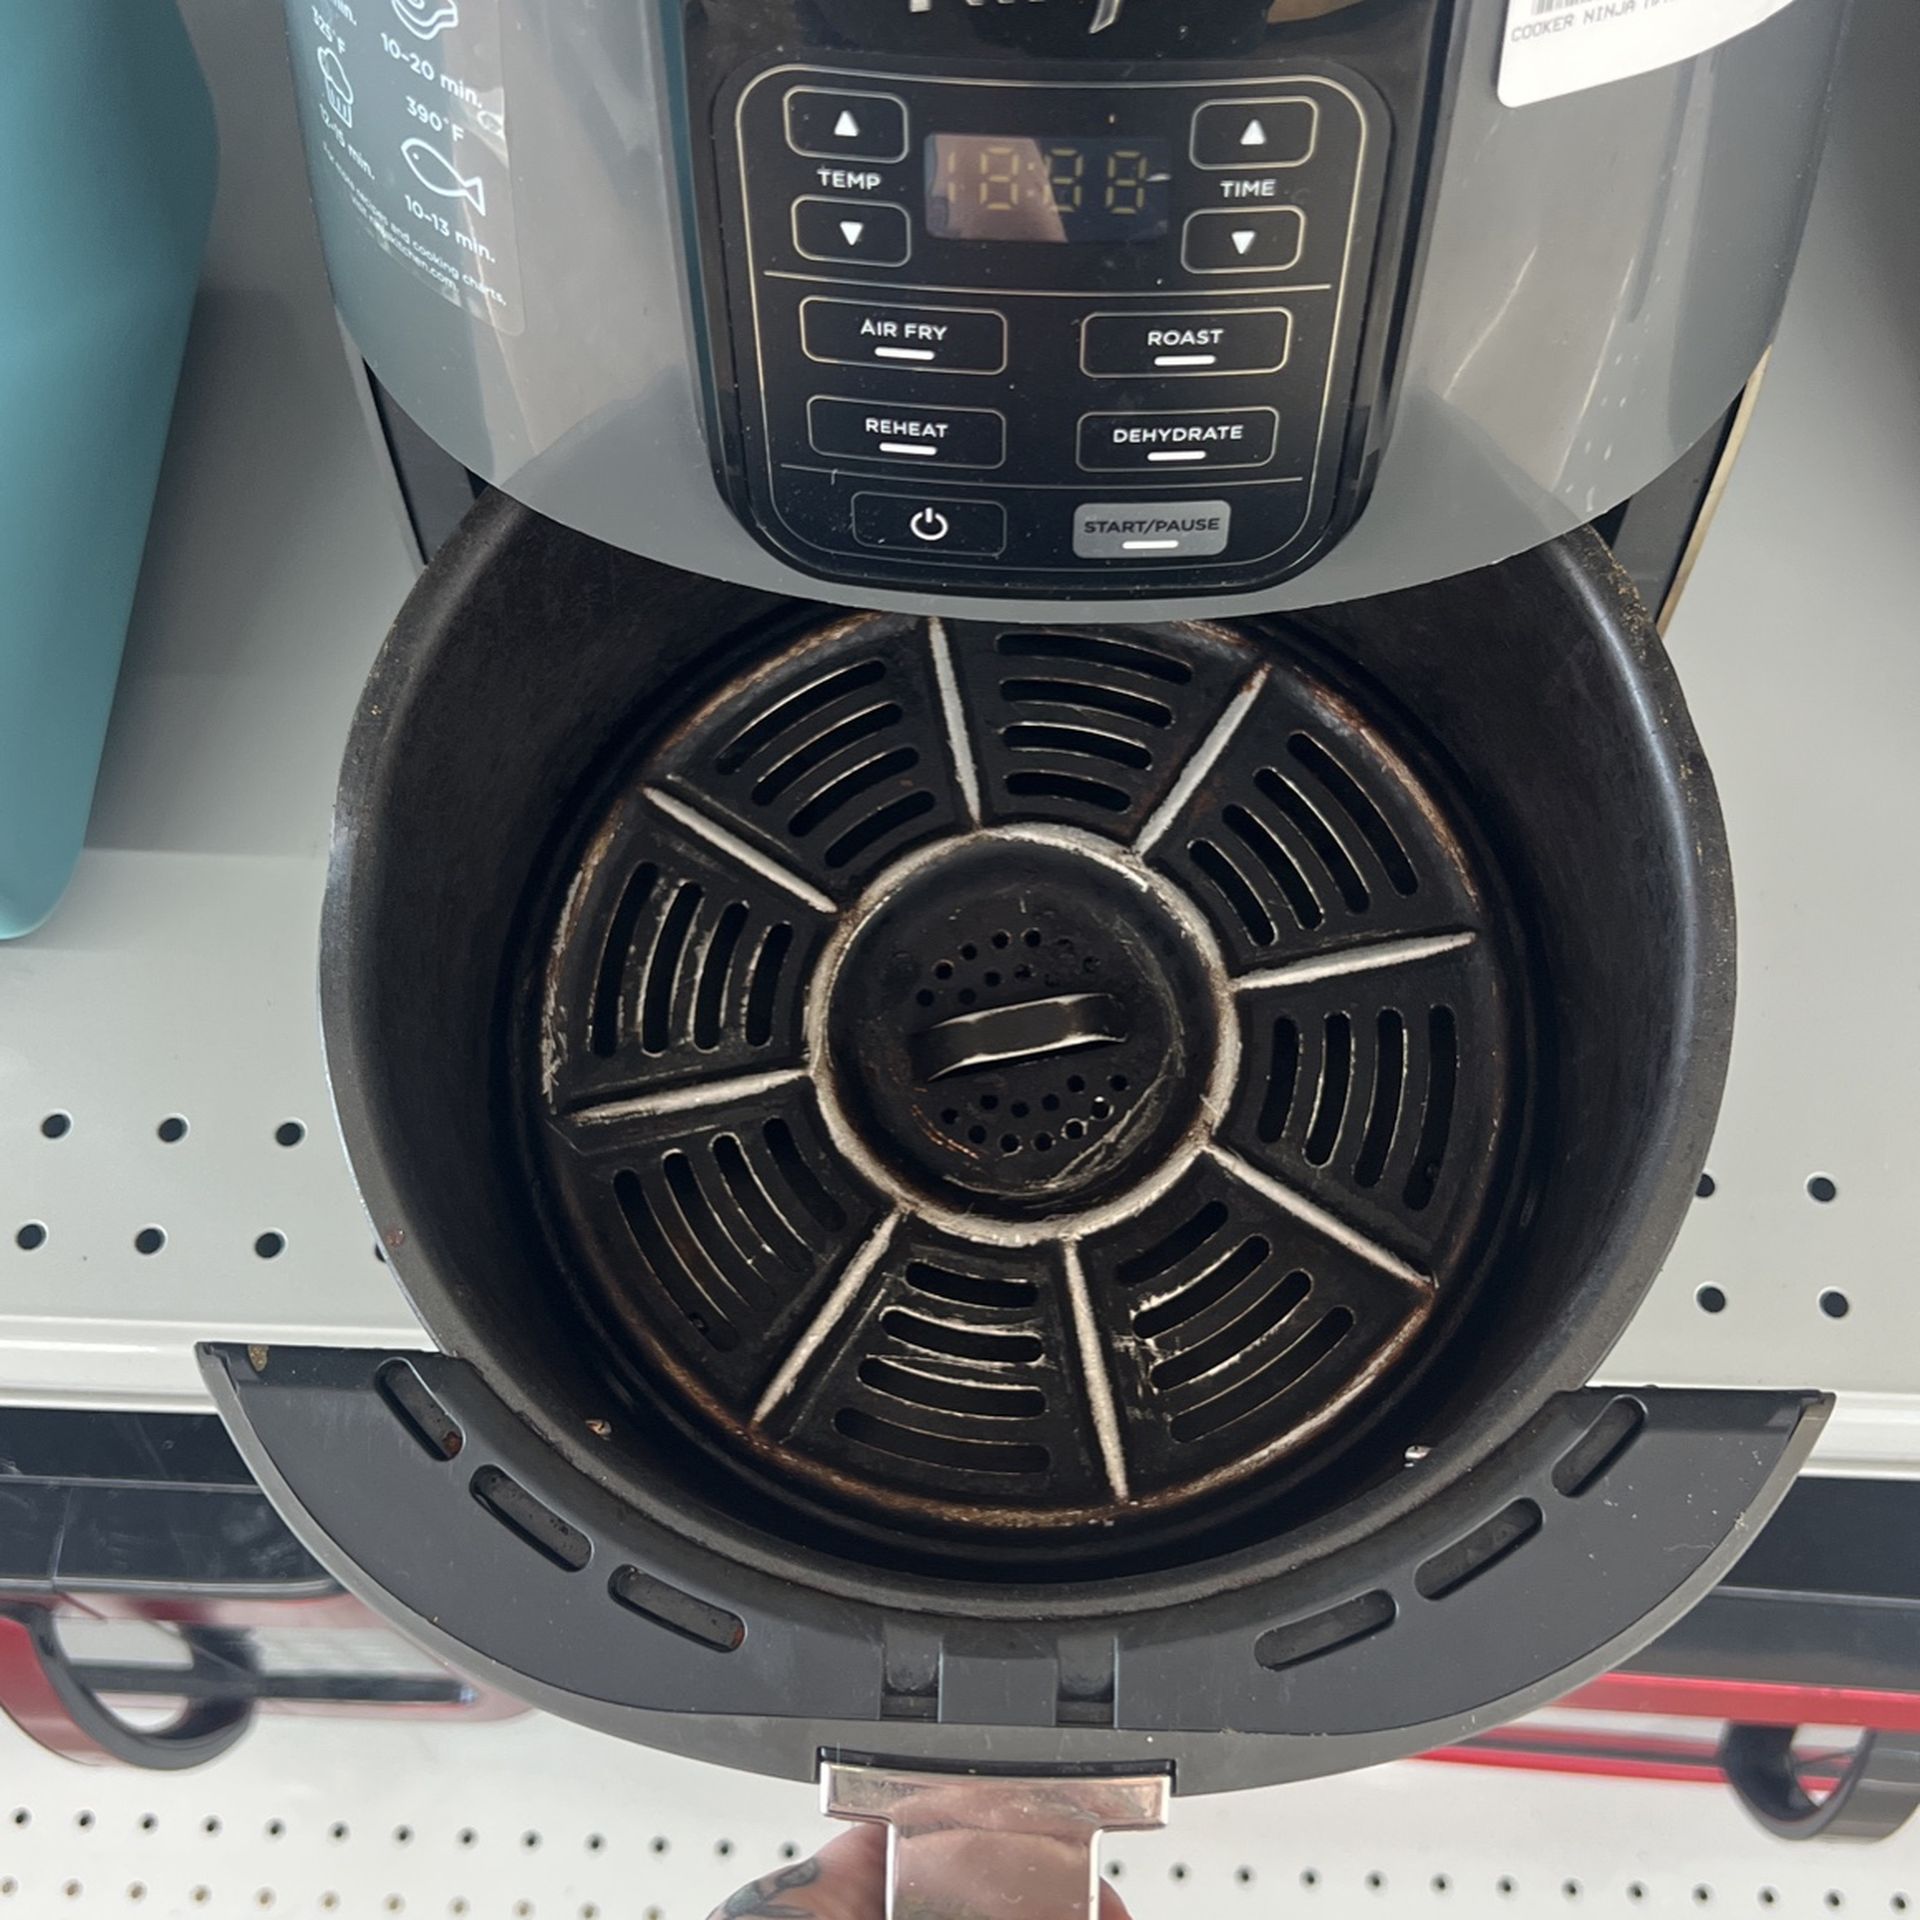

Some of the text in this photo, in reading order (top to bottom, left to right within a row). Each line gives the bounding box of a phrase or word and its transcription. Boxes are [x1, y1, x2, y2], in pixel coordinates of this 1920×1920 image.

[1511, 0, 1637, 43] COOKER NINJA
[381, 32, 483, 109] 10-20 min.
[816, 168, 882, 191] TEMP
[1219, 178, 1277, 198] TIME
[405, 194, 451, 237] 10-13
[455, 230, 496, 263] min.
[860, 319, 948, 342] AIR FRY
[1147, 329, 1224, 347] ROAST
[865, 418, 949, 438] REHEAT
[1113, 424, 1244, 444] DEHYDRATE
[1083, 517, 1222, 535] START/PAUSE
